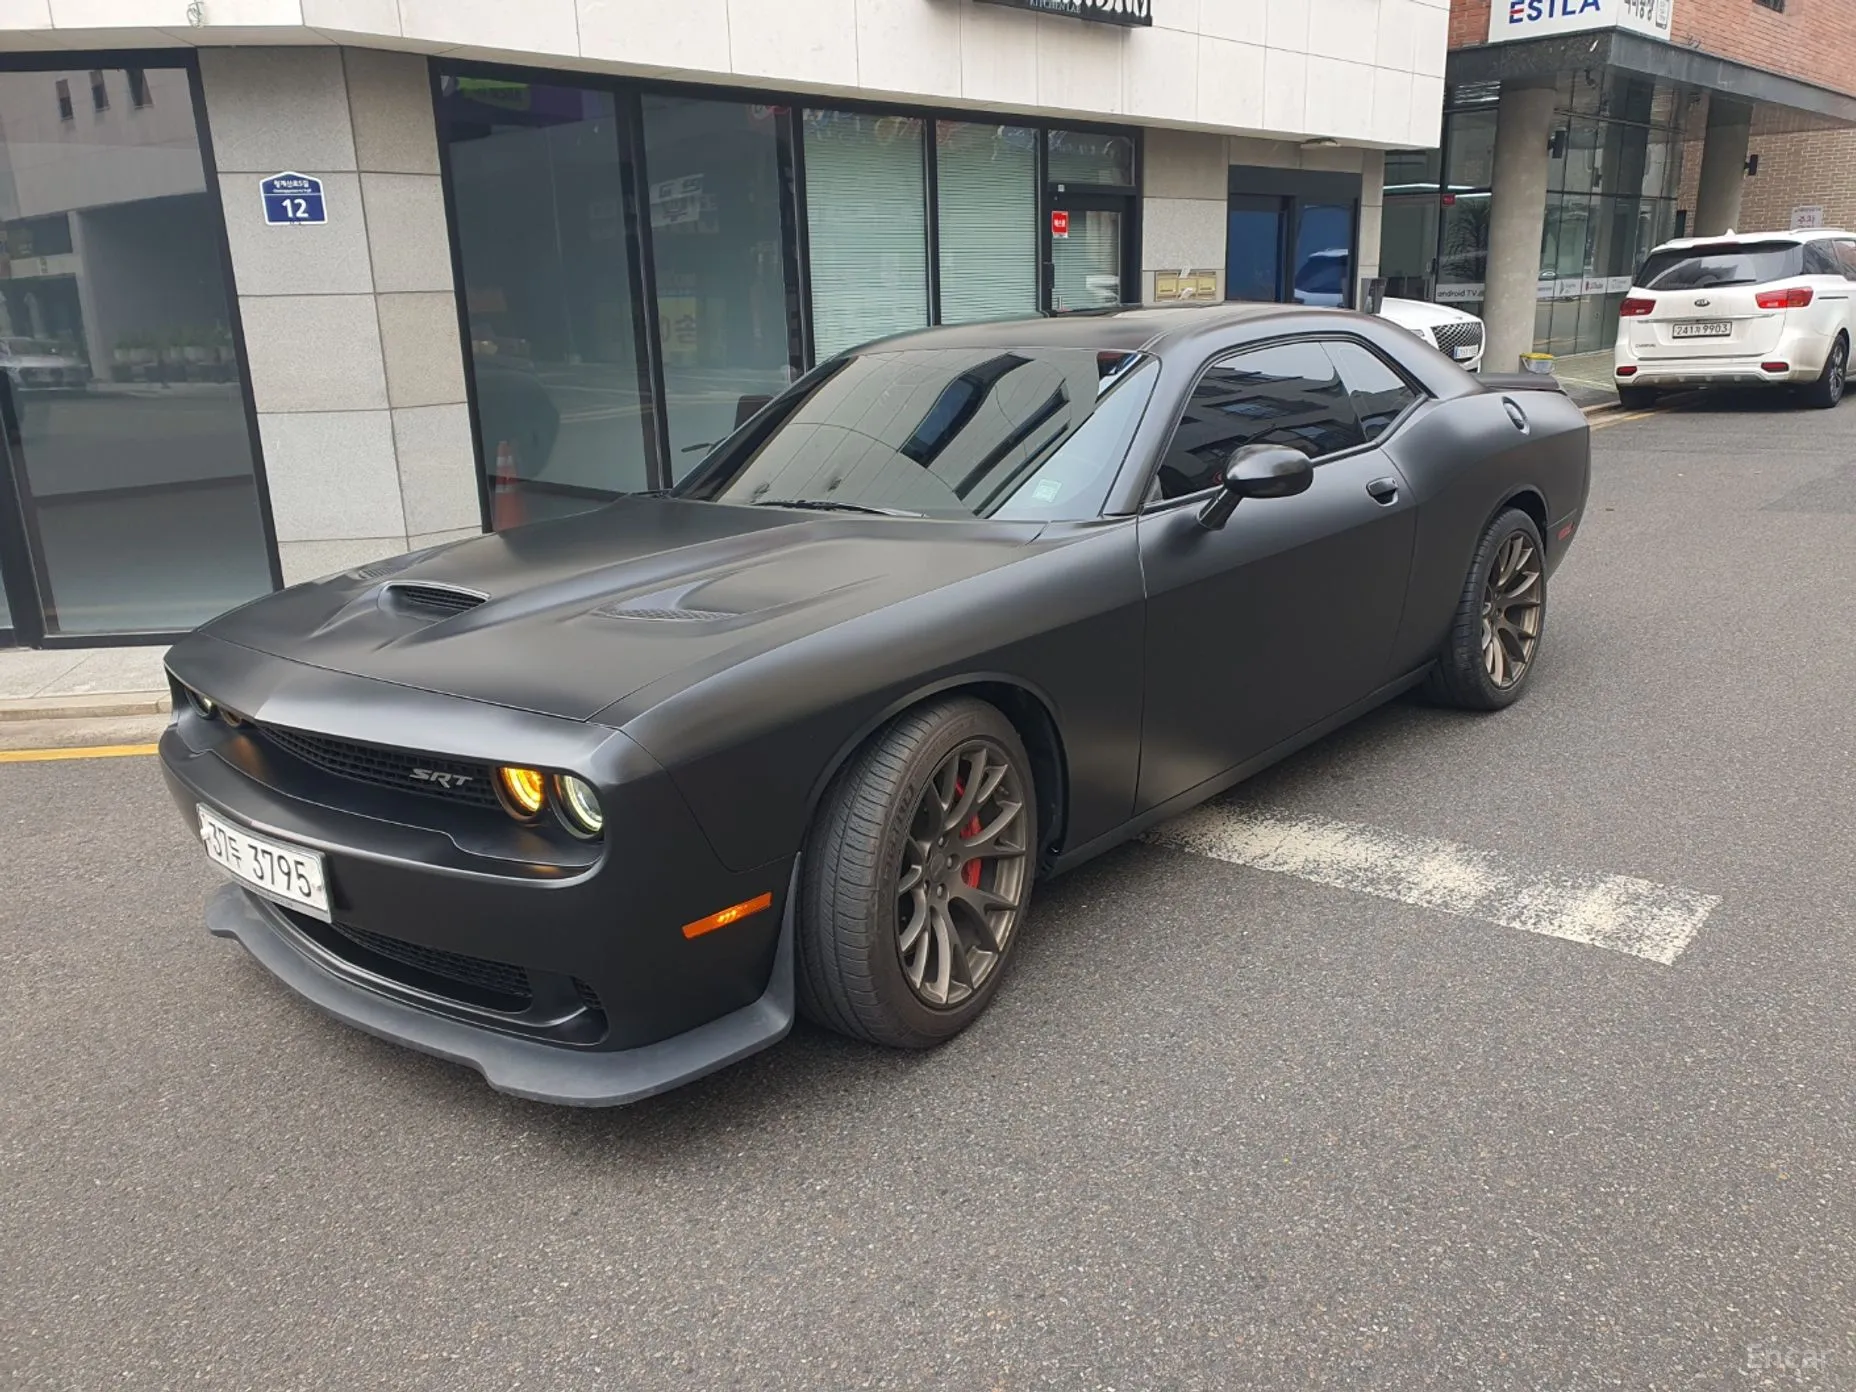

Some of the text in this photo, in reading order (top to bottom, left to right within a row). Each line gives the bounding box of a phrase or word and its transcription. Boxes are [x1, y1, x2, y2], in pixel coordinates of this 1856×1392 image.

[281, 198, 309, 218] 12
[1437, 288, 1478, 298] android TV
[1703, 324, 1728, 334] 9903
[409, 768, 473, 789] SRT
[247, 843, 312, 898] 3795
